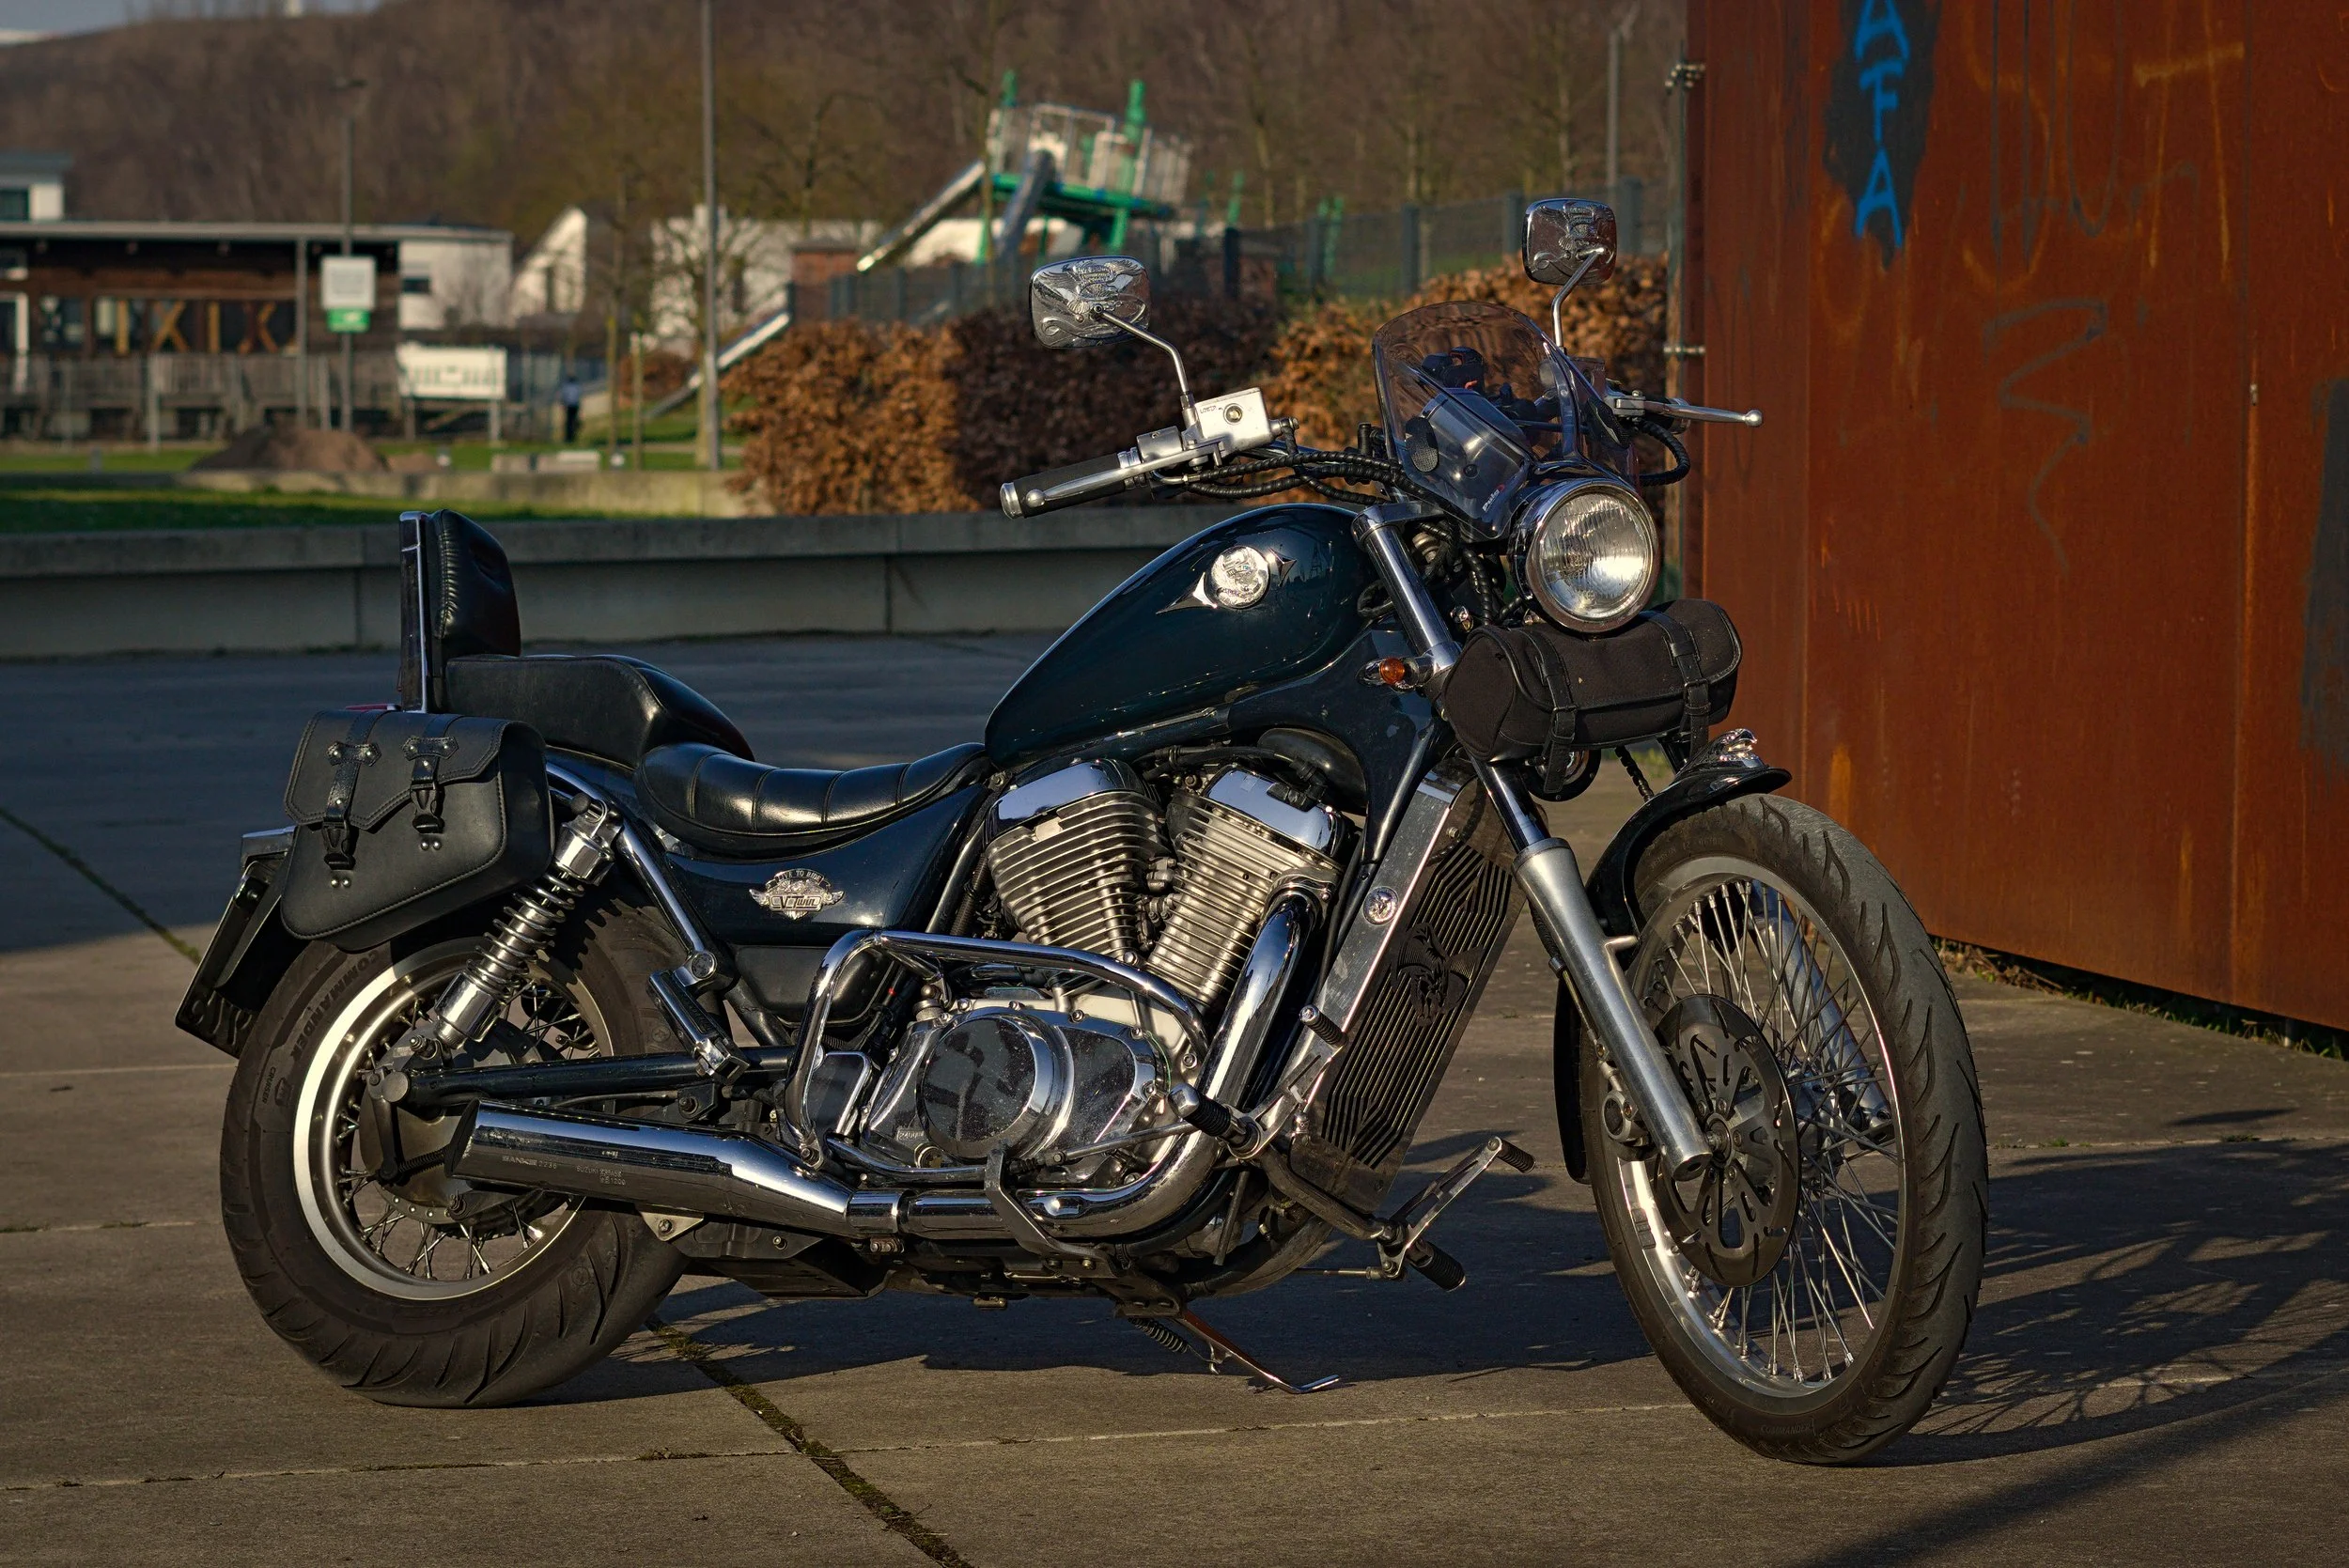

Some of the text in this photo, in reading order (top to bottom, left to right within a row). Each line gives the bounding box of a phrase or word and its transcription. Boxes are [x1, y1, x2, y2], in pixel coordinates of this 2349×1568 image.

[778, 871, 793, 882] LIVE
[806, 871, 821, 881] RIDE
[290, 950, 381, 1062] COMMANDER
[262, 1066, 277, 1105] CRUISER
[576, 1165, 599, 1173] SUZUKI
